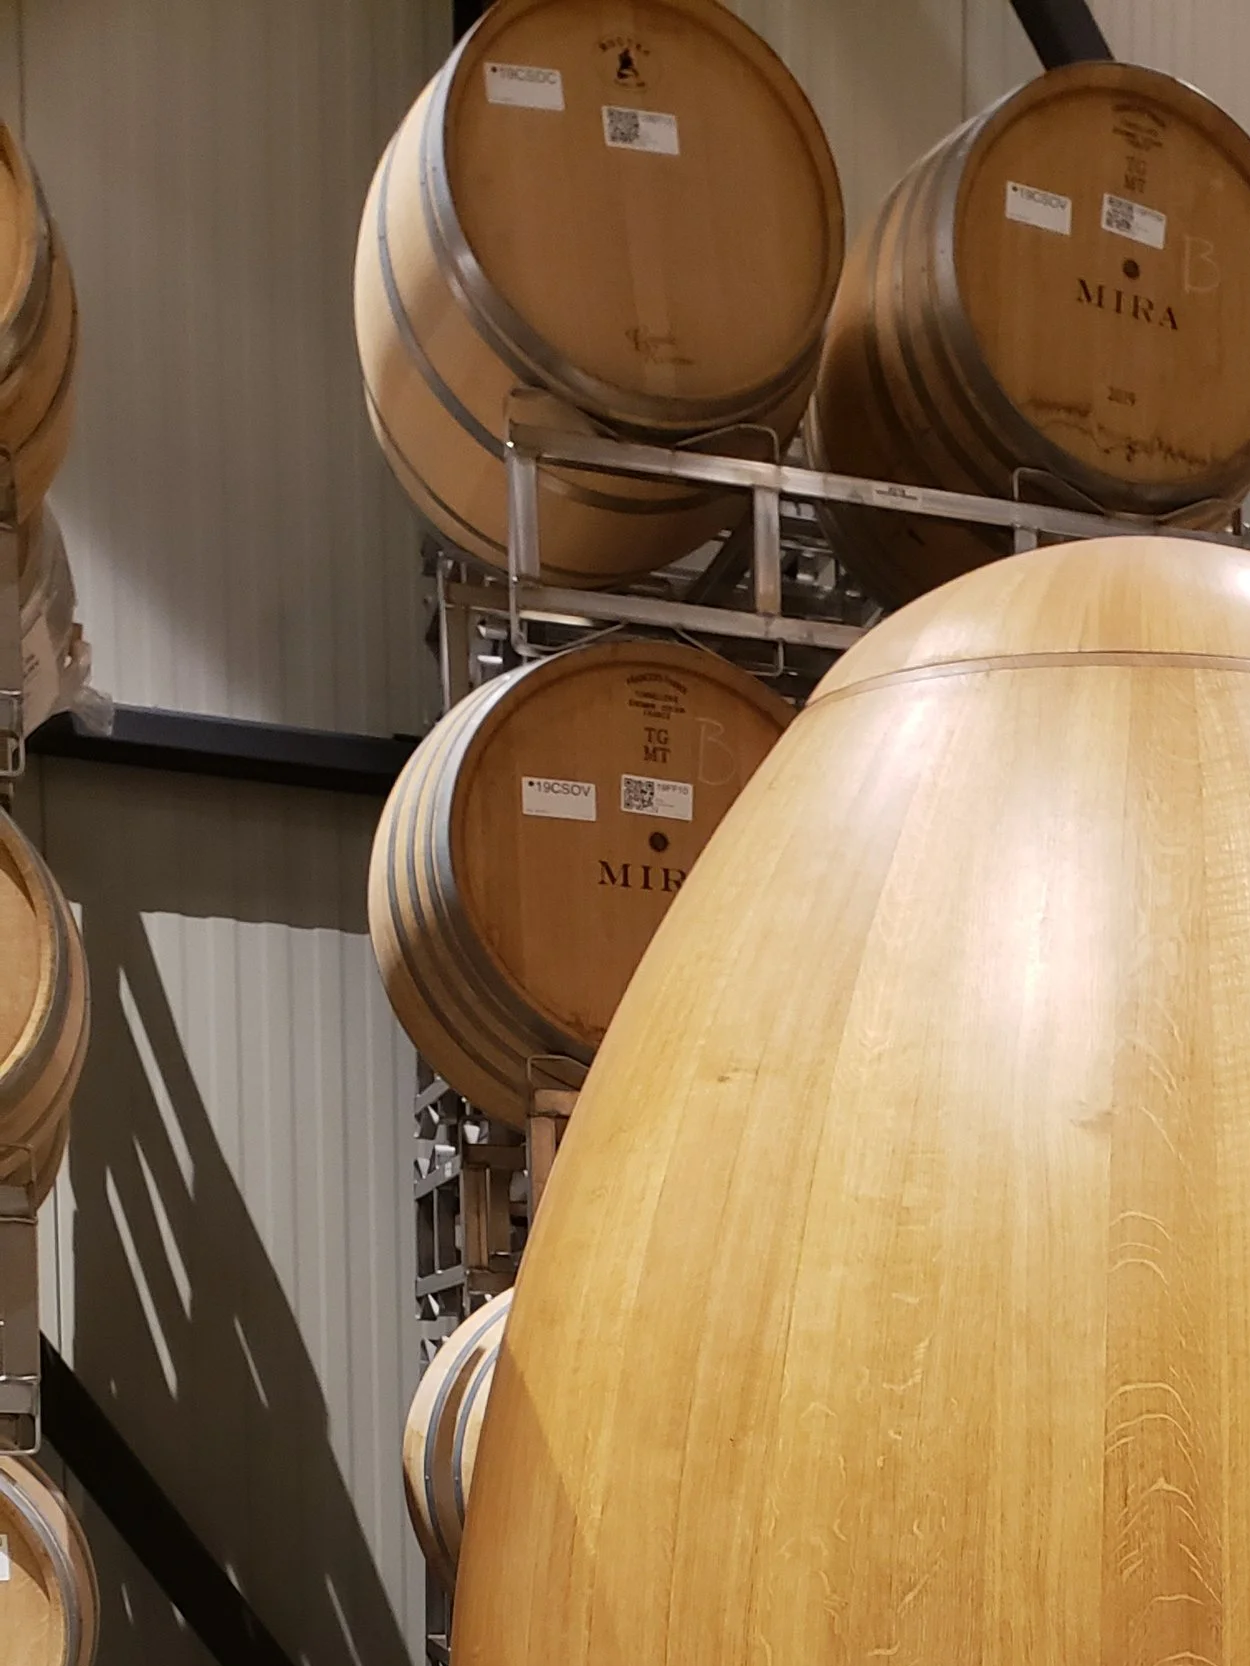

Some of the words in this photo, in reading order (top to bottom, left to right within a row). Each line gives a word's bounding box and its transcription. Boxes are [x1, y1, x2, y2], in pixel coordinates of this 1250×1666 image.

[1076, 277, 1179, 331] MIRA
[644, 727, 670, 745] TG
[643, 745, 671, 763] MT
[536, 780, 592, 798] 19CSOV
[598, 859, 688, 893] MIR
